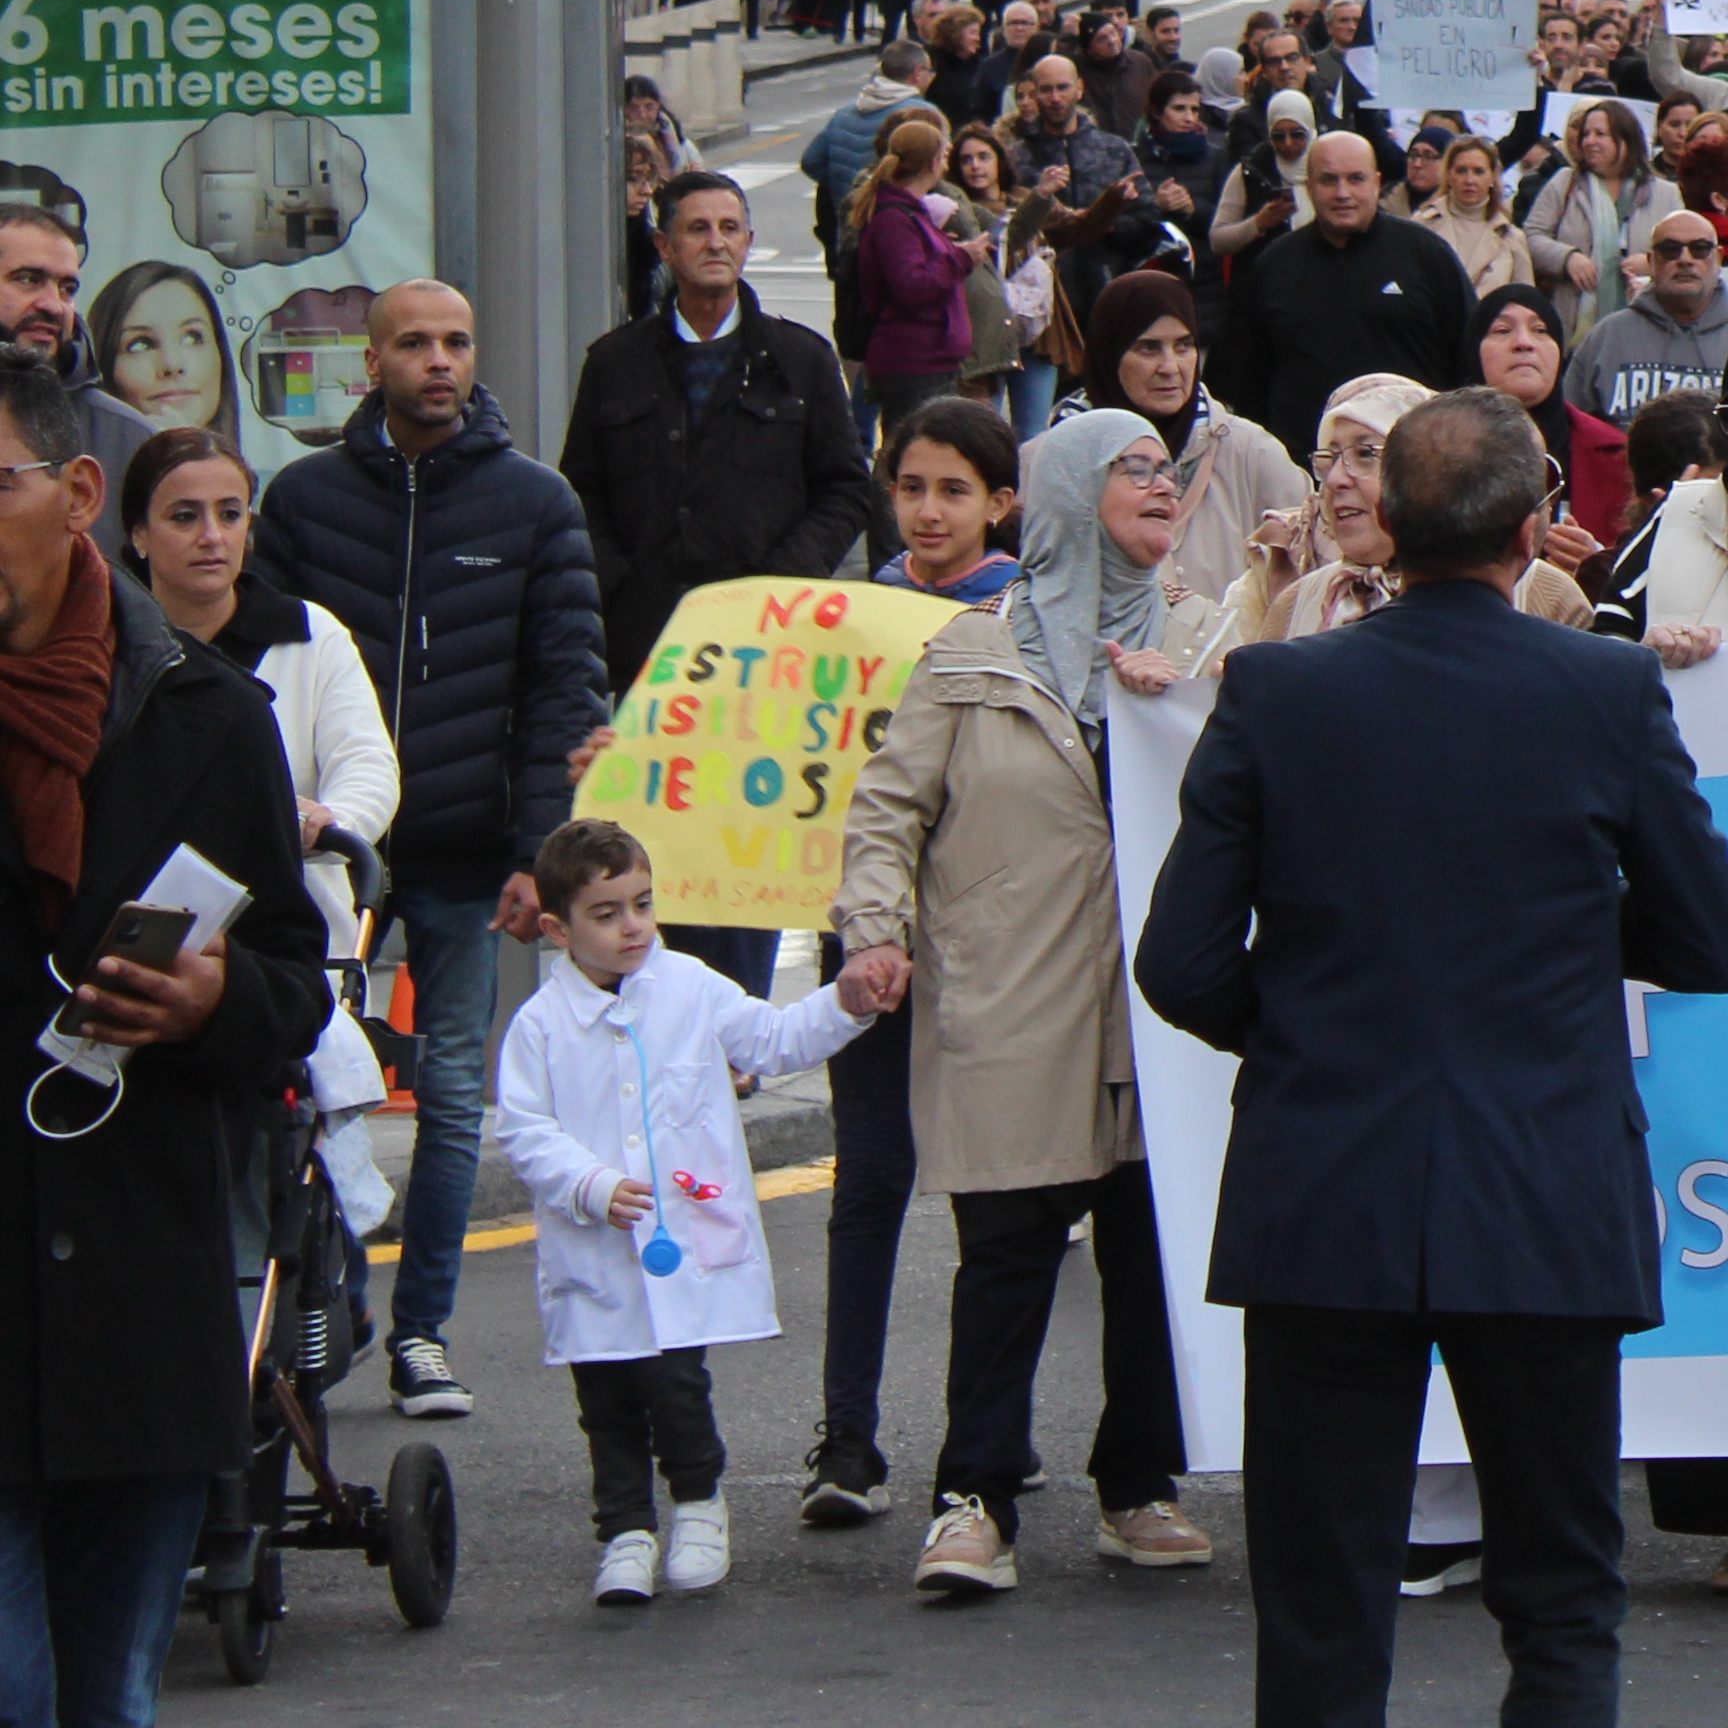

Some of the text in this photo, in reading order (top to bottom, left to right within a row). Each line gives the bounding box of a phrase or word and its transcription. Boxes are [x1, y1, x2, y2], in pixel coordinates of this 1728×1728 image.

[82, 1, 381, 63] meses
[1439, 25, 1466, 46] EN
[4, 59, 383, 113] sin intereses!
[1401, 46, 1498, 81] PELIGRO
[757, 587, 850, 636] NO
